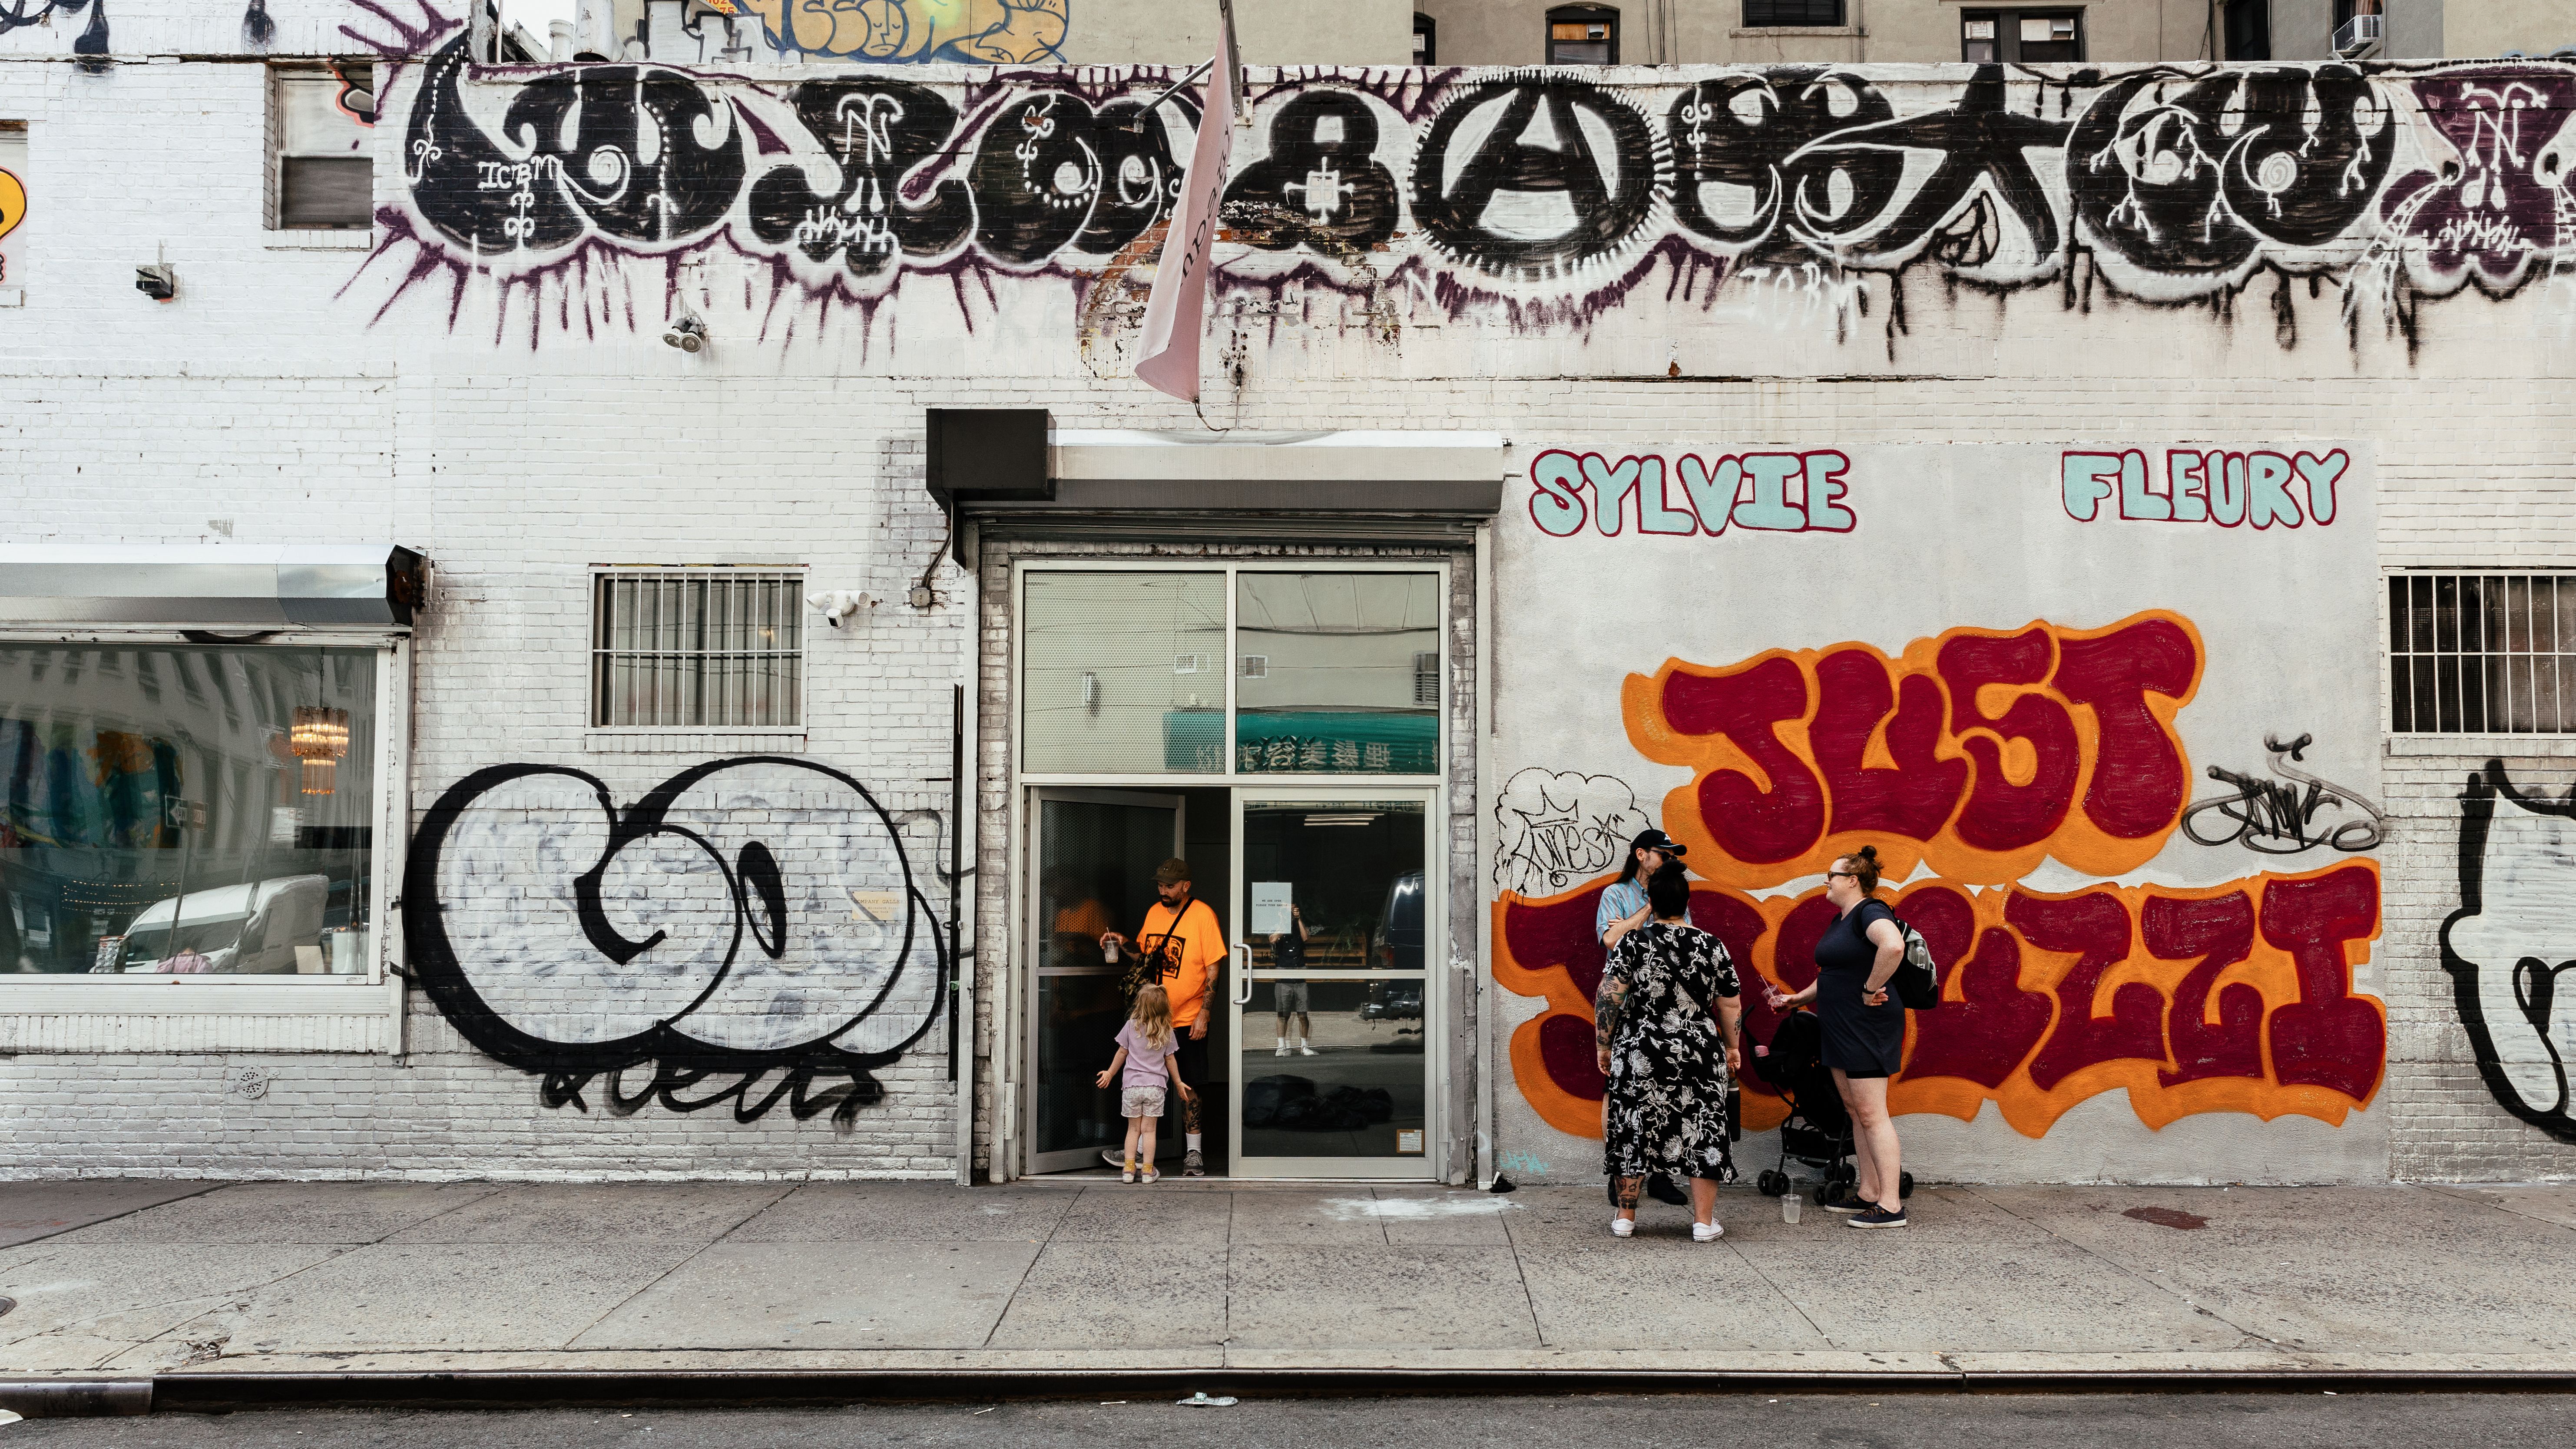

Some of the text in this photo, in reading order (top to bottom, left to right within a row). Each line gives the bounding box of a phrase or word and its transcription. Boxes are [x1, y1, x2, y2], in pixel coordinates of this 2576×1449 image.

[1529, 448, 2350, 537] SYLVIE FLEURY
[1646, 613, 2202, 875] JUST
